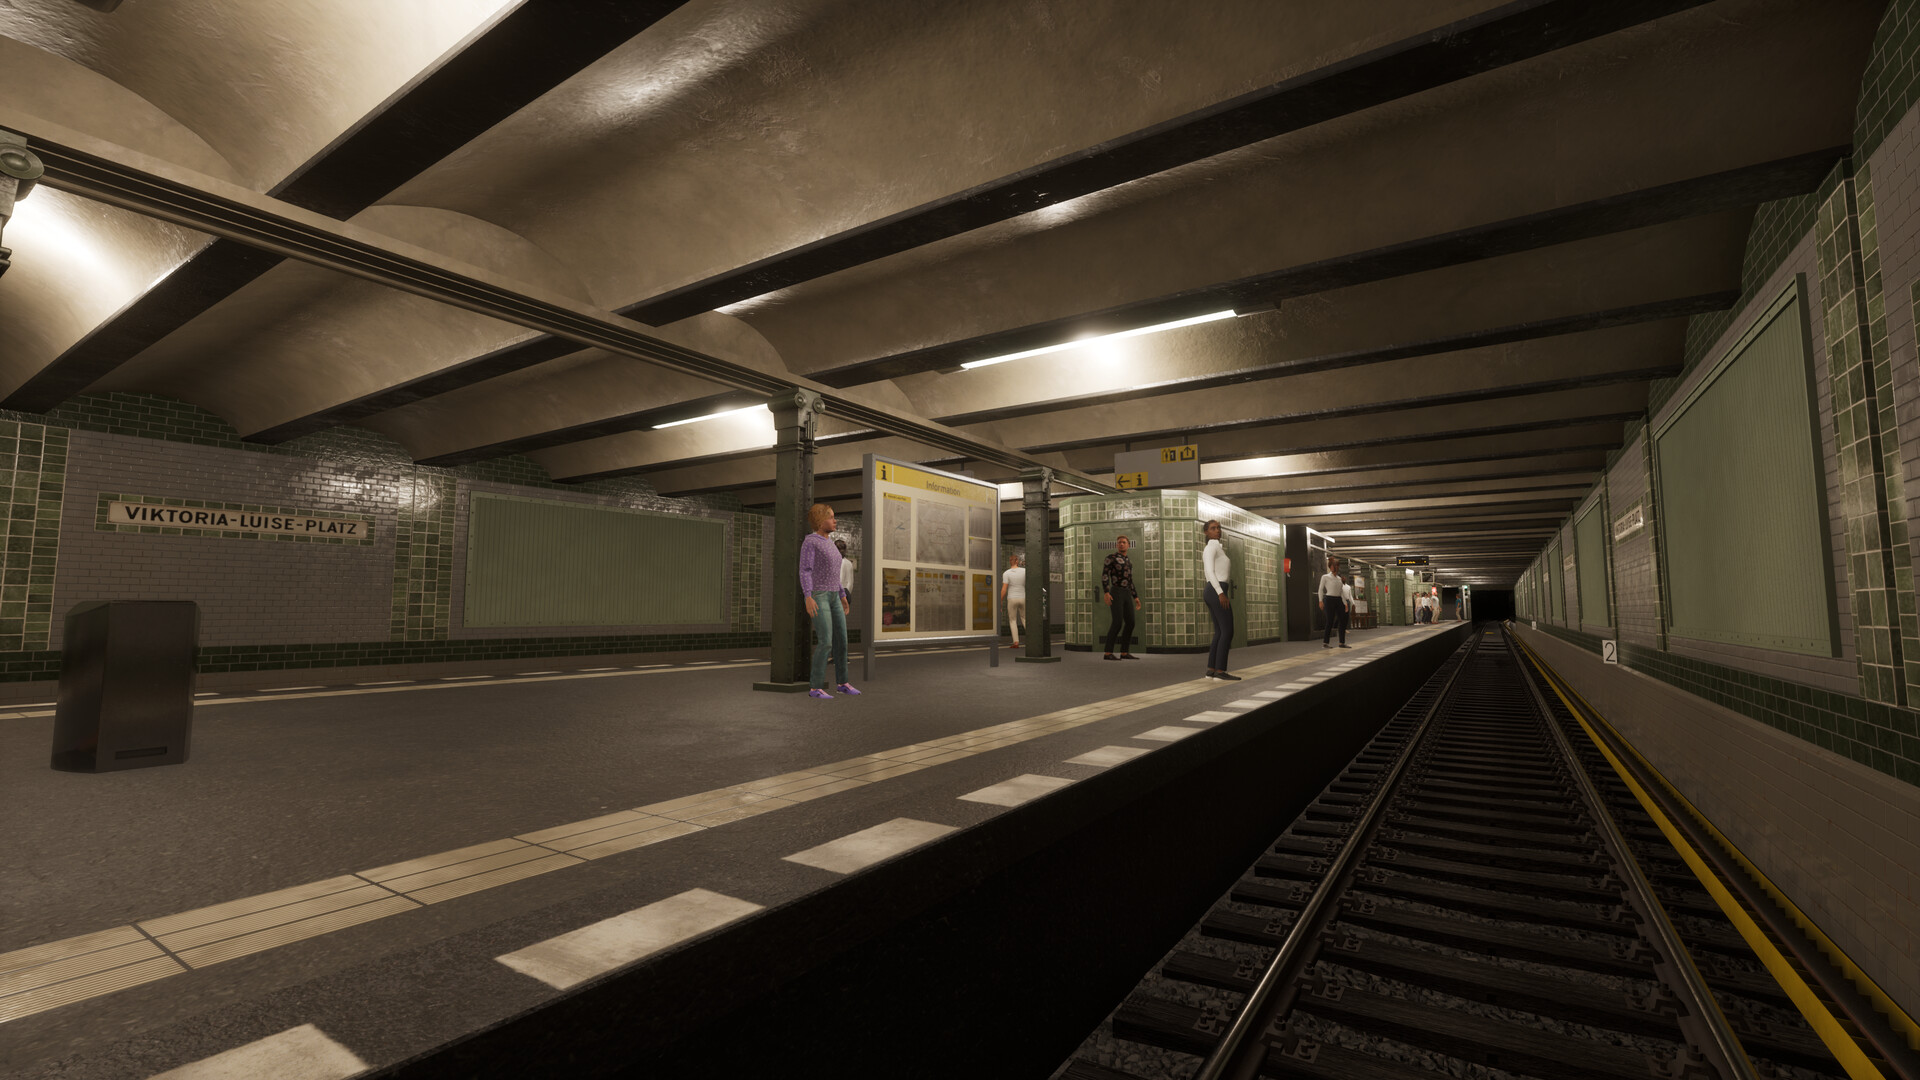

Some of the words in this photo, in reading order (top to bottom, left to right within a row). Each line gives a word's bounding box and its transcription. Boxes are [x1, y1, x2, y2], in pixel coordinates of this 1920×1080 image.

[926, 480, 961, 497] Information
[124, 505, 358, 535] VIKTORIA-LUISE-PLATZ
[1604, 641, 1616, 663] 2
